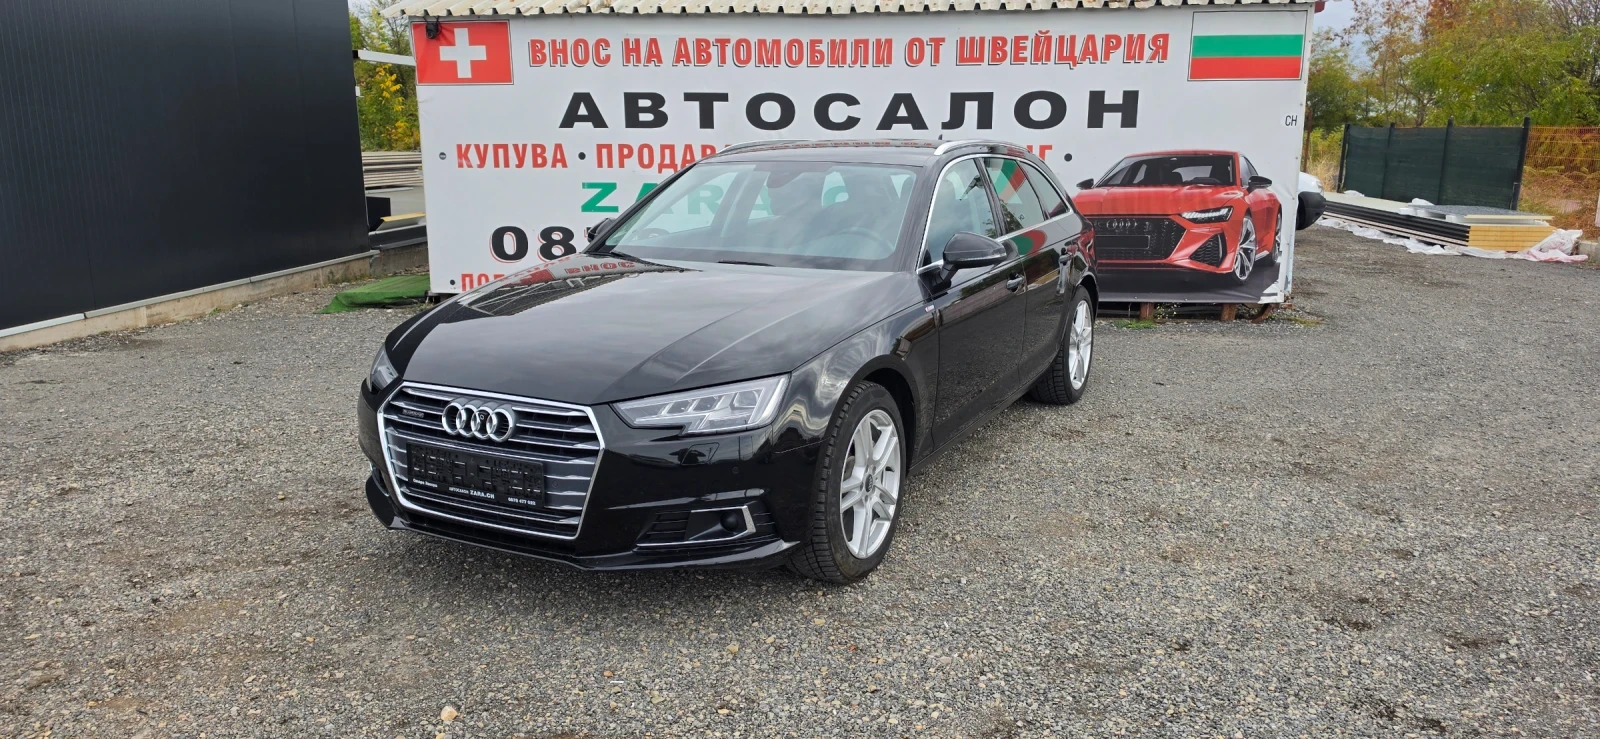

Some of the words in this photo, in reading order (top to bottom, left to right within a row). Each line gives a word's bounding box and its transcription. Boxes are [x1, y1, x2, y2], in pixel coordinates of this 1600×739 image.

[528, 38, 611, 68] ВНОС
[622, 37, 664, 67] НА
[672, 37, 893, 68] АВТОМОБИЛИ
[905, 37, 946, 67] ОТ
[956, 30, 1170, 69] ШВЕЙЦАРИЯ
[559, 90, 1139, 131] АВТОСАЛОН
[456, 143, 568, 169] КУПУВА
[595, 143, 732, 174] ПРОДАВ
[469, 489, 495, 499] ZARA.CH
